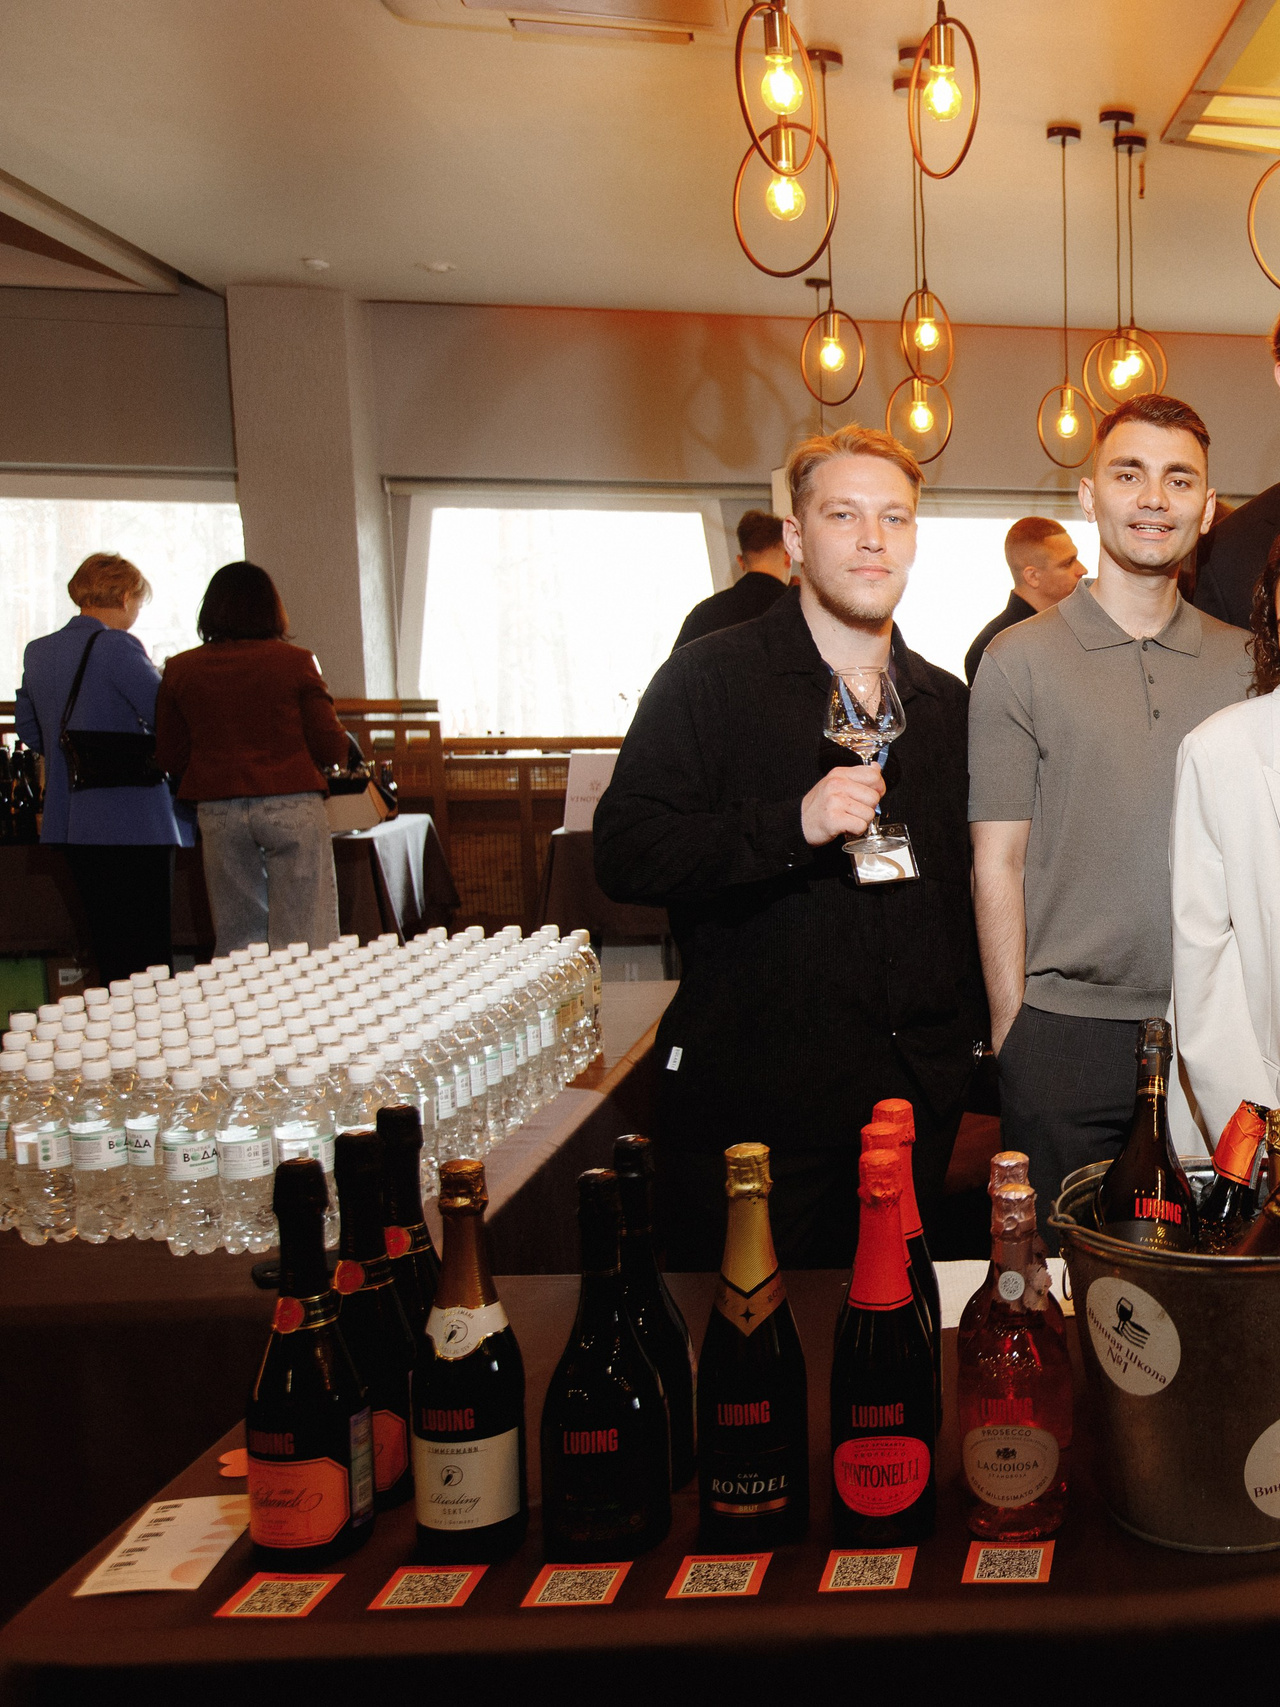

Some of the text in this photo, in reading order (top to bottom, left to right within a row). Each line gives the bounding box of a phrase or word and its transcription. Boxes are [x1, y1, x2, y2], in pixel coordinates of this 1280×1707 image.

[1134, 1197, 1182, 1224] LUDING
[1107, 1344, 1129, 1374] №1
[1125, 1348, 1167, 1385] Школа
[421, 1407, 476, 1432] LUDING
[717, 1400, 771, 1426] LUDING
[851, 1402, 905, 1428] LUDING
[563, 1428, 619, 1455] LUDING
[981, 1428, 1032, 1437] PROSECCO
[712, 1474, 789, 1495] RONDEL
[986, 1489, 1034, 1501] MILLESIMATO
[430, 1492, 482, 1514] Riesling
